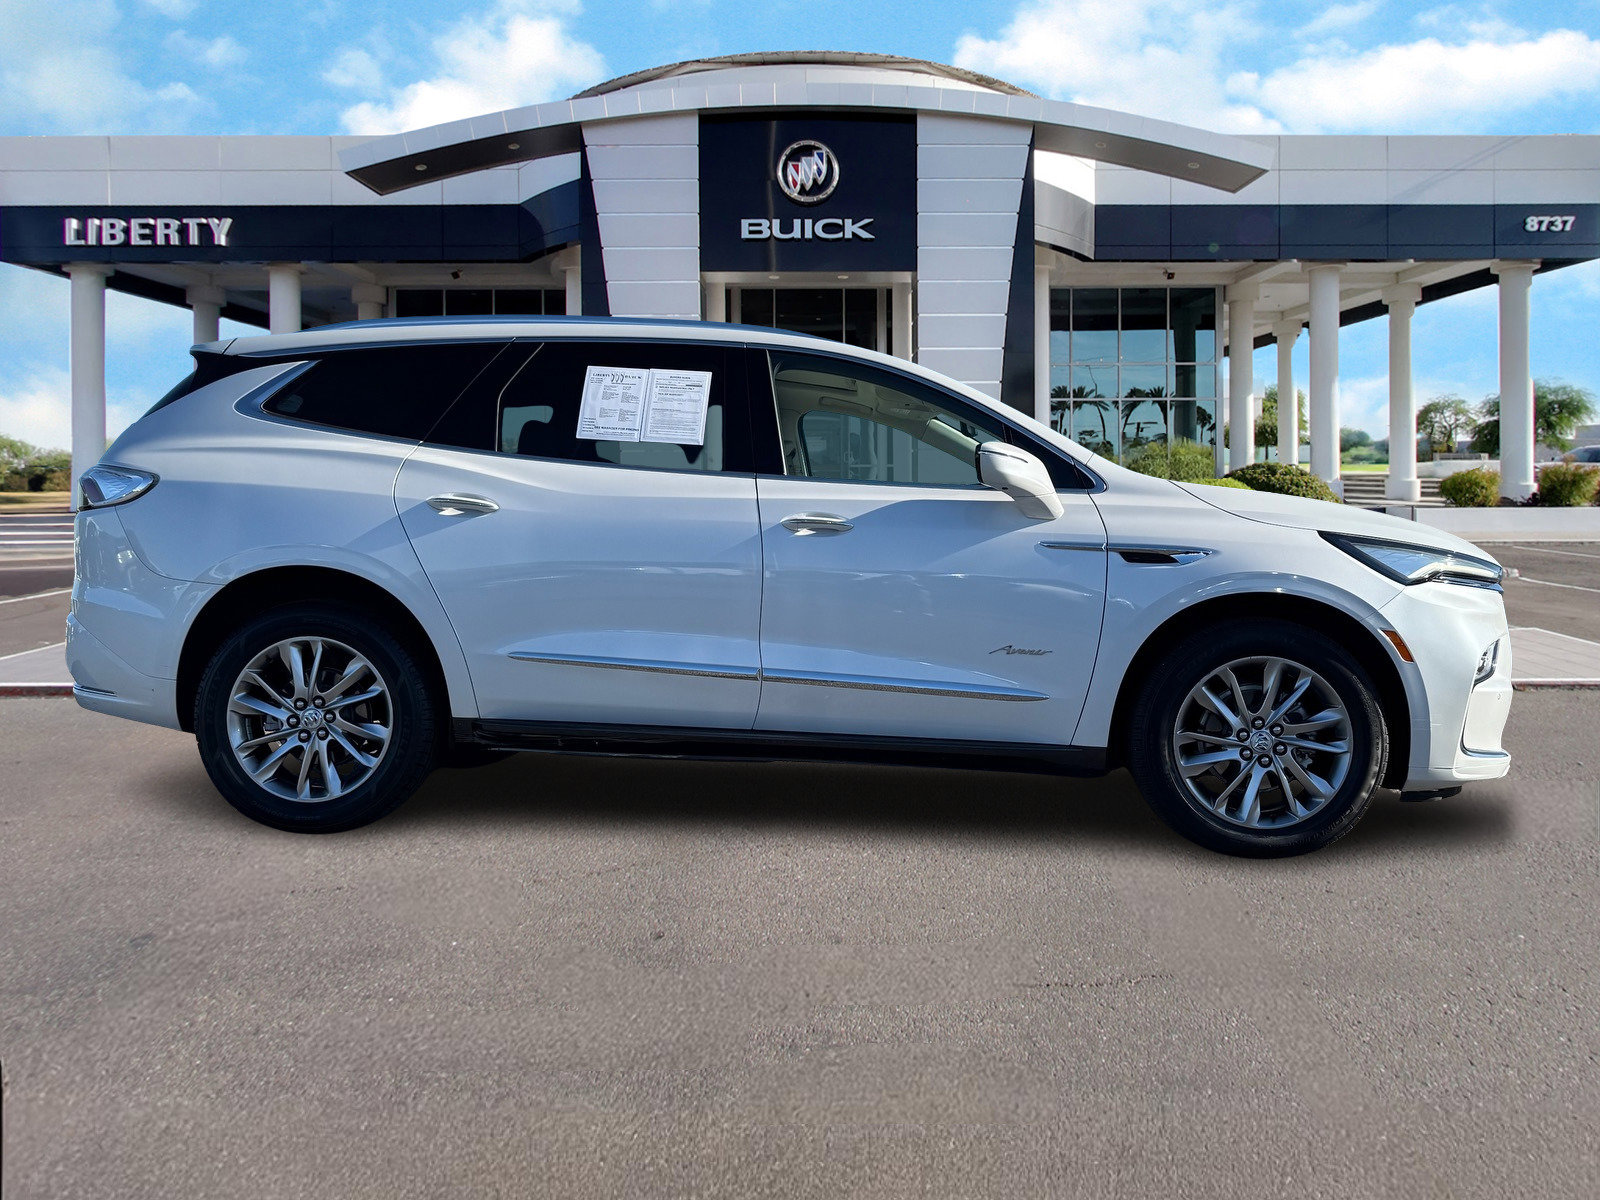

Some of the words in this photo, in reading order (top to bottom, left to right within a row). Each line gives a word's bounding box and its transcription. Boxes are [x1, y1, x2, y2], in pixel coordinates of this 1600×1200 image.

[64, 217, 233, 246] LIBERTY
[740, 218, 876, 239] BUICK
[1524, 215, 1576, 232] 8737
